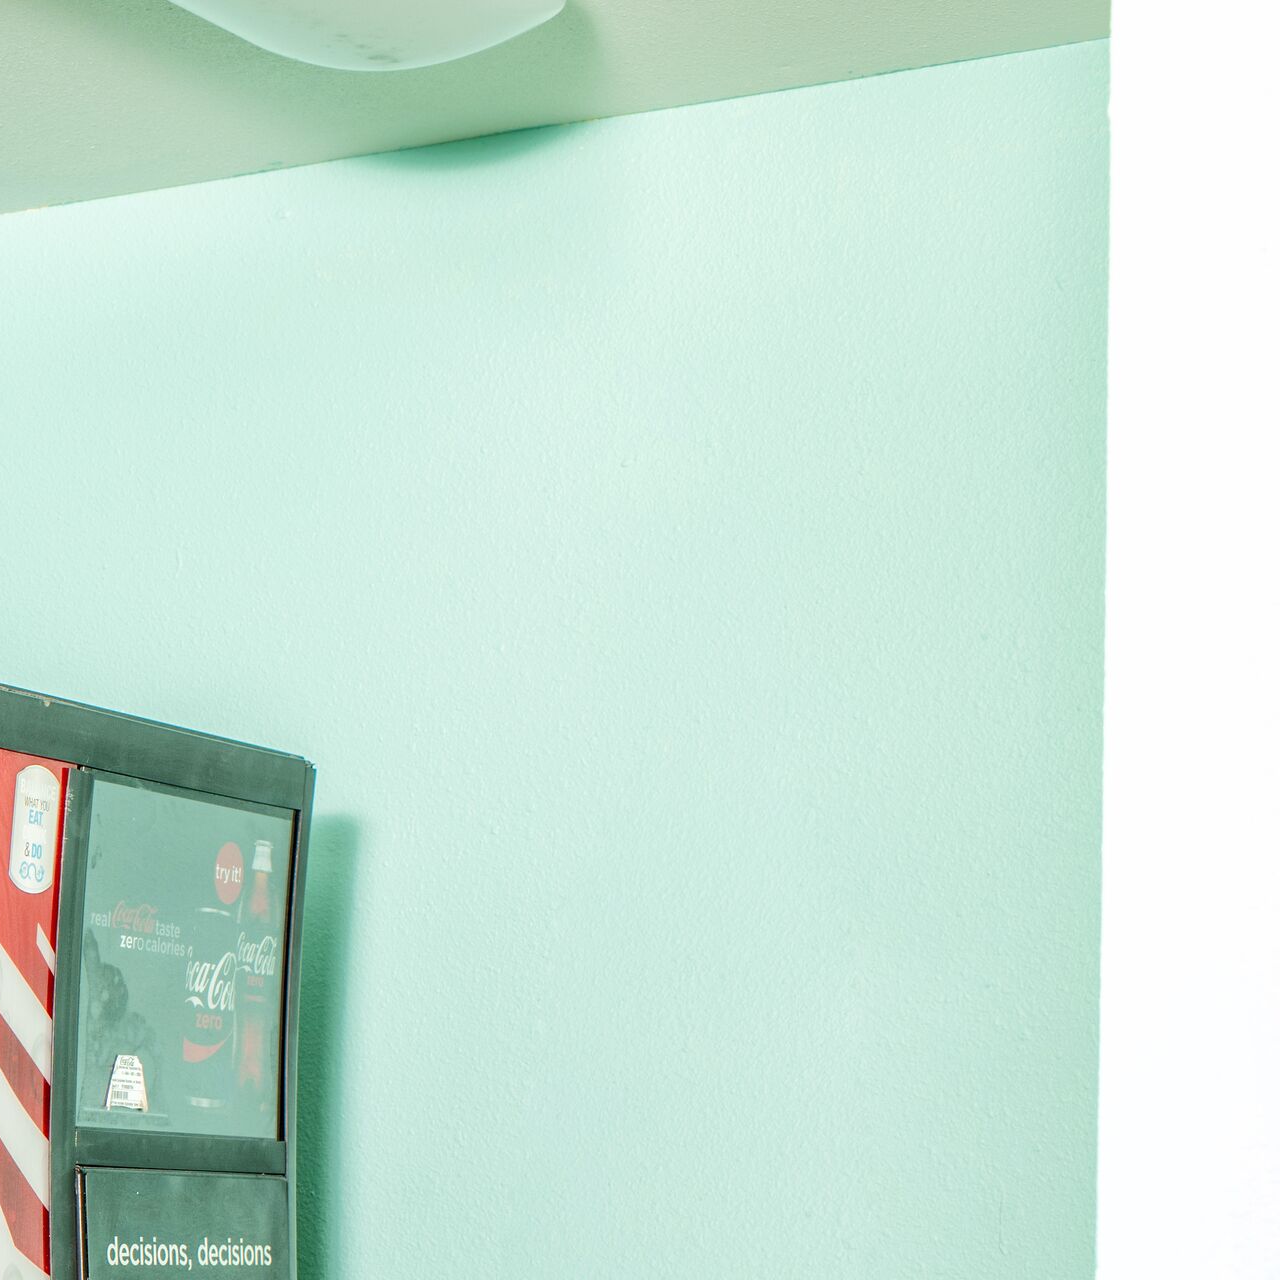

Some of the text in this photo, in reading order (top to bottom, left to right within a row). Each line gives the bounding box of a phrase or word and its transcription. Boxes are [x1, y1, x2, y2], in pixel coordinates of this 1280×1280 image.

[31, 843, 43, 860] DO
[216, 864, 242, 884] try it!
[90, 911, 111, 928] real
[155, 920, 181, 939] taste
[119, 934, 186, 957] zero calories
[195, 1012, 223, 1031] zero
[106, 1236, 273, 1271] decisions, decisions
